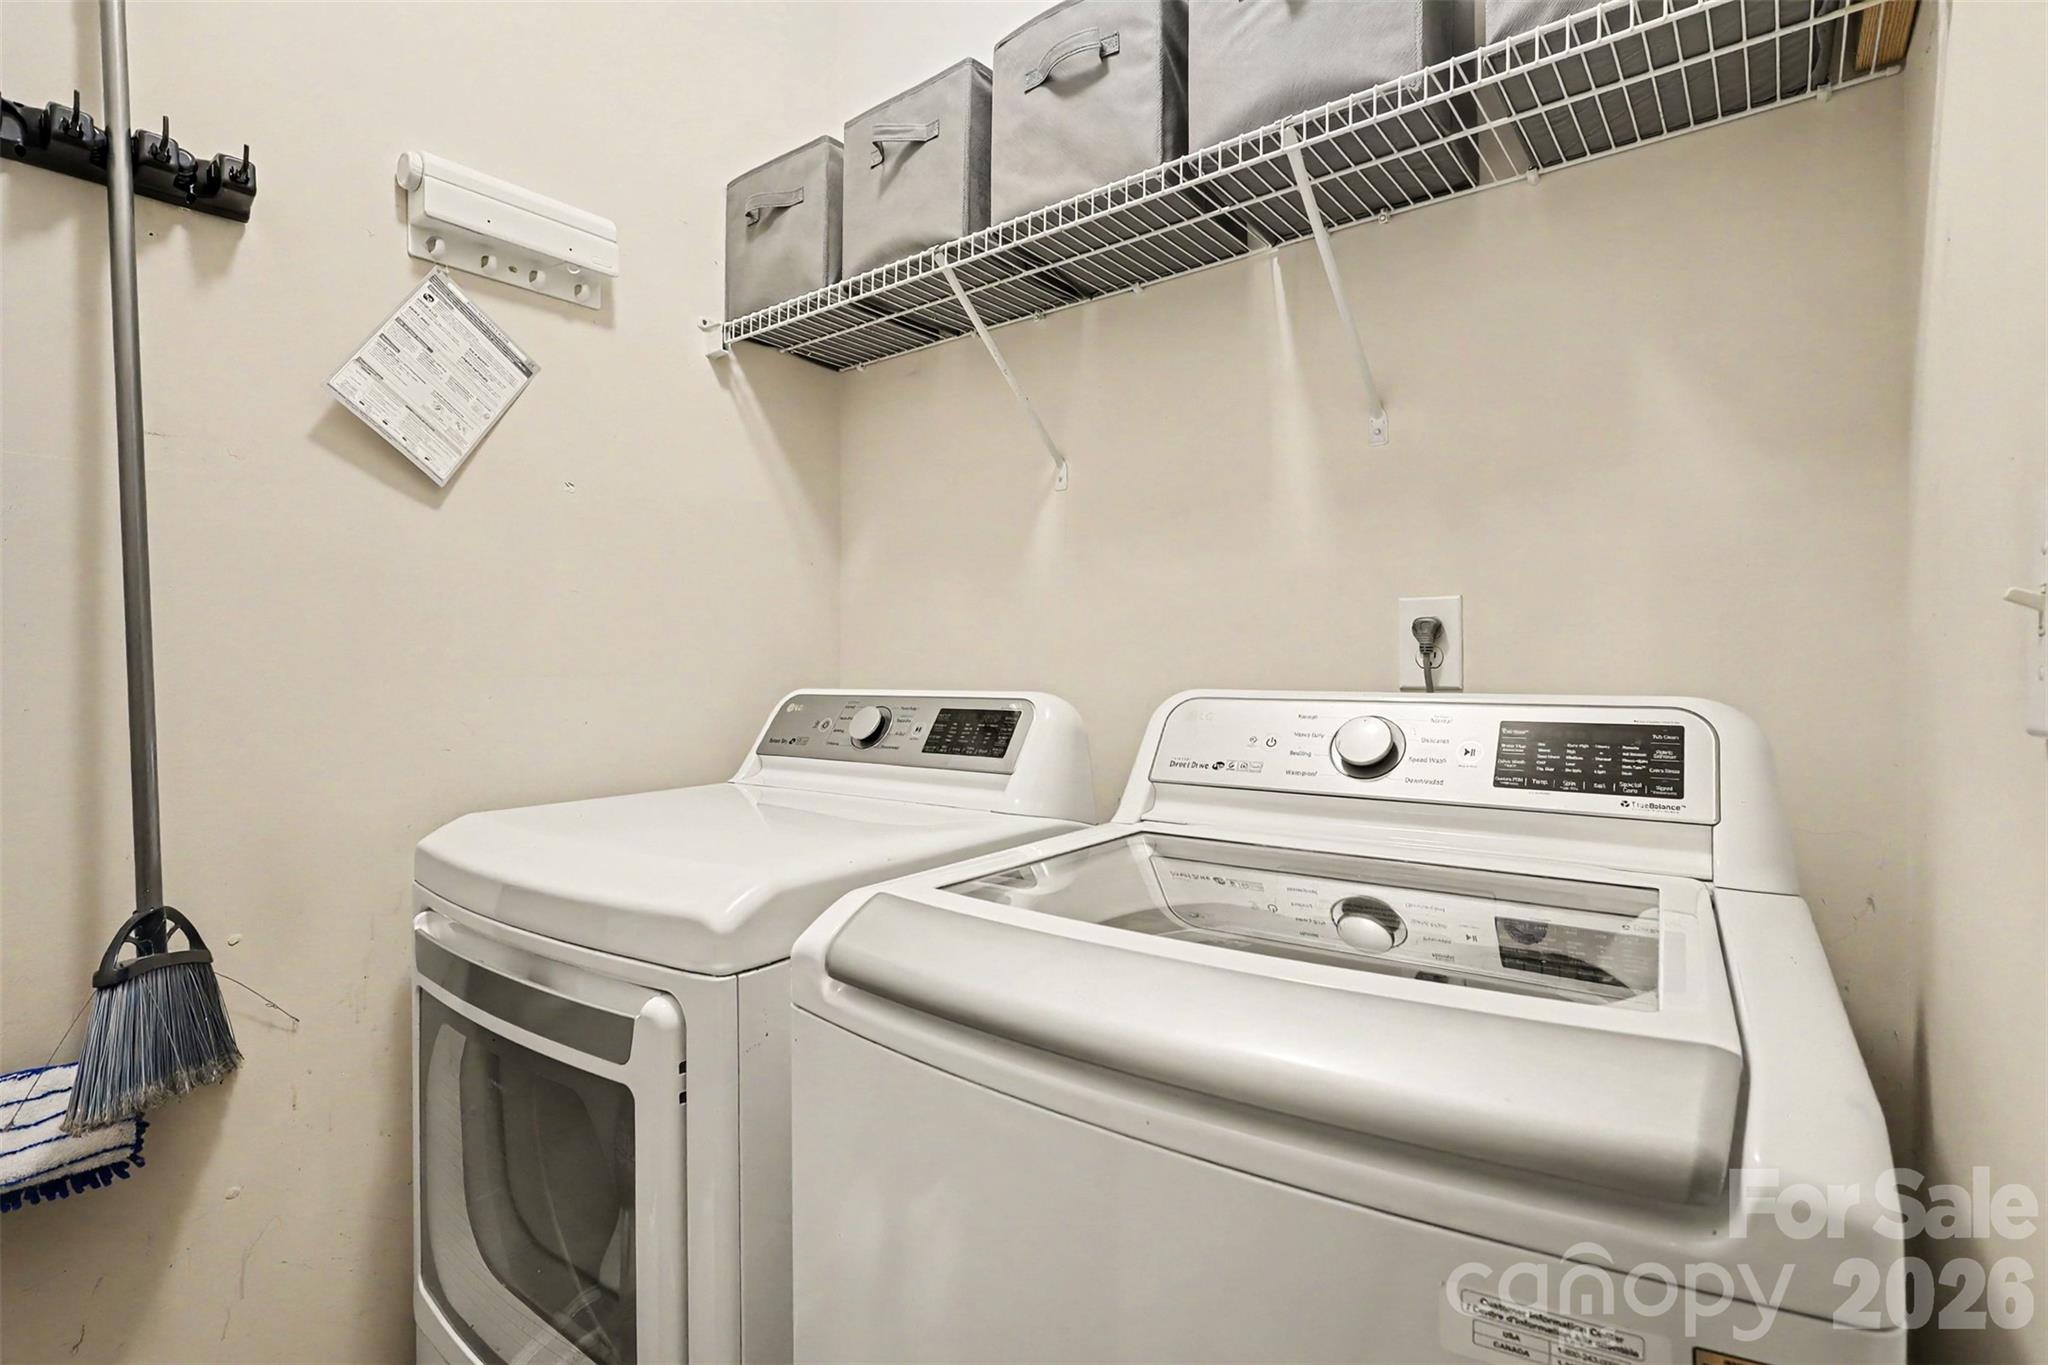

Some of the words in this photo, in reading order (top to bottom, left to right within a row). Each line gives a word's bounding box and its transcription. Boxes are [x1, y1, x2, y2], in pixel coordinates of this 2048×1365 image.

[1289, 750, 1312, 758] Bedding
[1501, 1331, 1521, 1343] USA
[1492, 1341, 1532, 1358] CANADA
